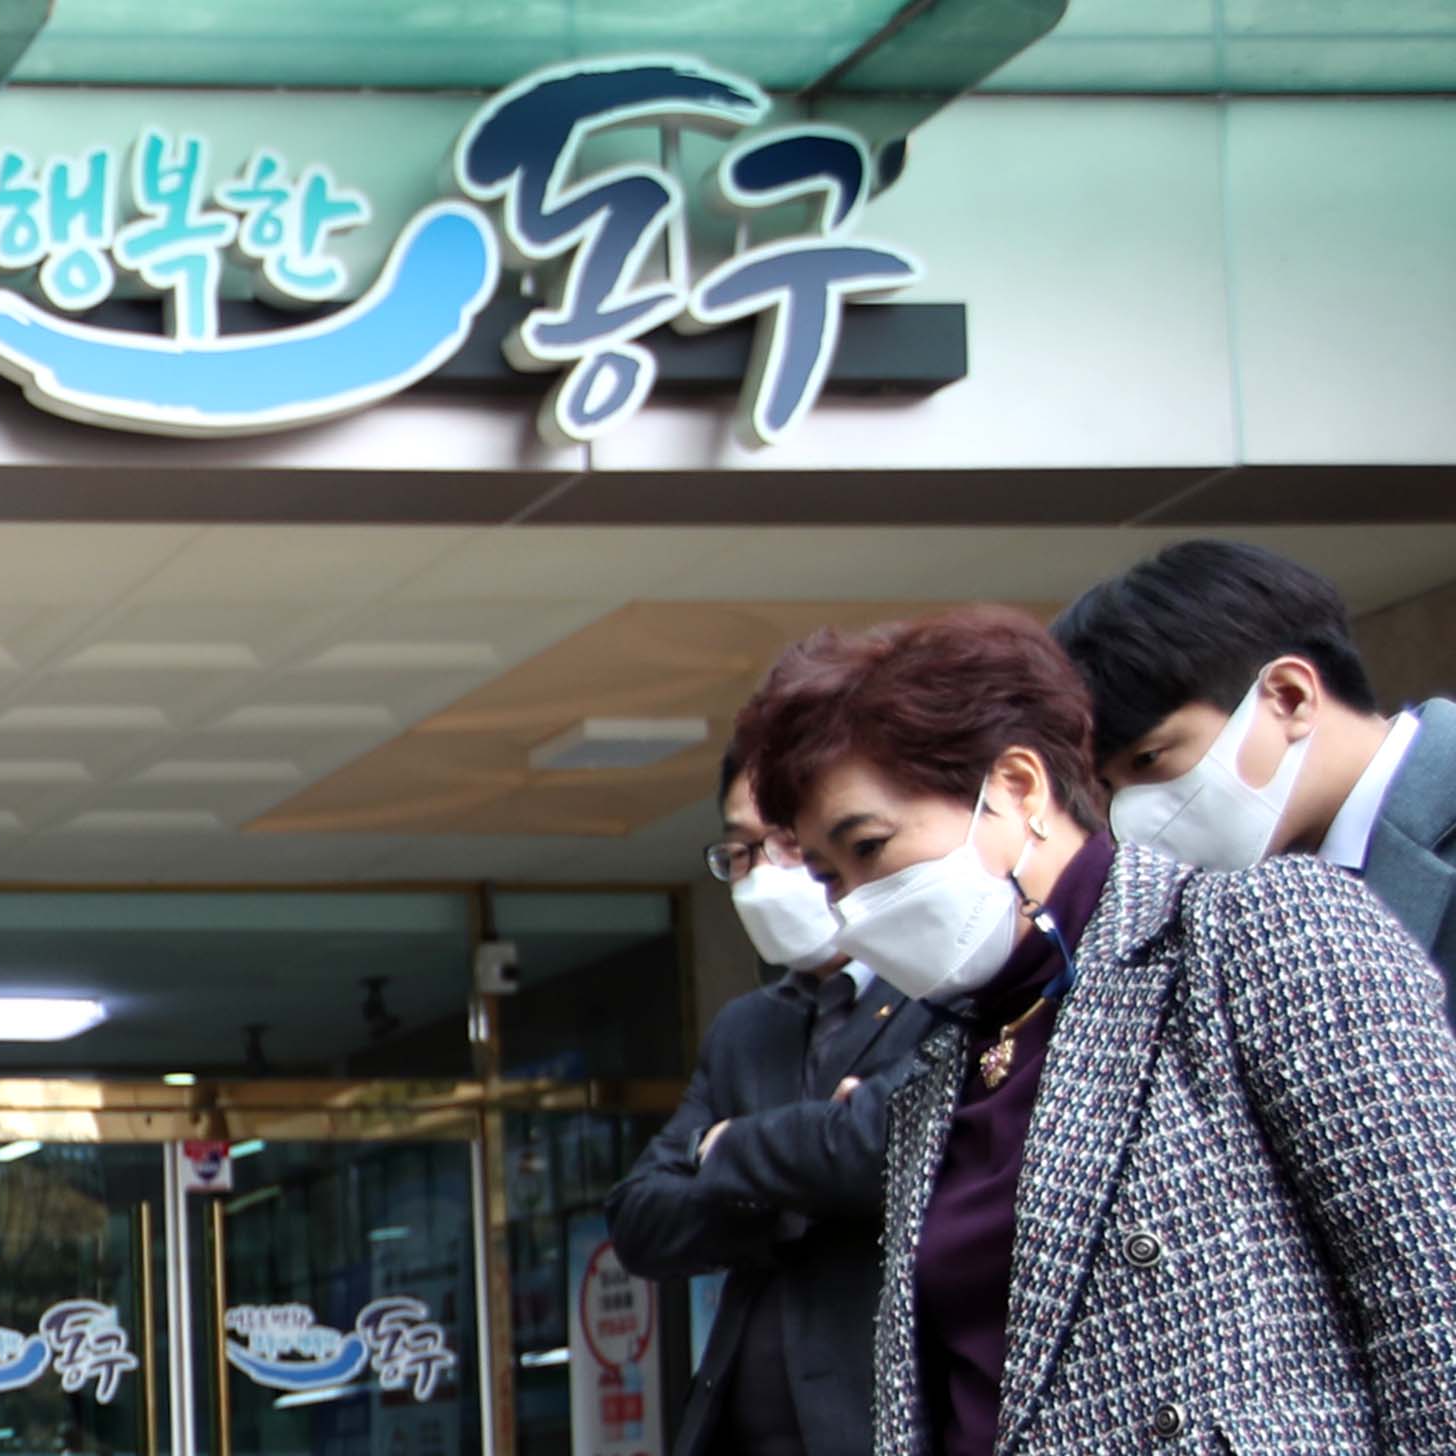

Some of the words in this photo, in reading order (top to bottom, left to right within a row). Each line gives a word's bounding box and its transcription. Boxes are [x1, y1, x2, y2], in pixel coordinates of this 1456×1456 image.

[455, 56, 925, 444] 동구
[40, 1299, 138, 1404] 동구
[356, 1297, 455, 1401] 동구
